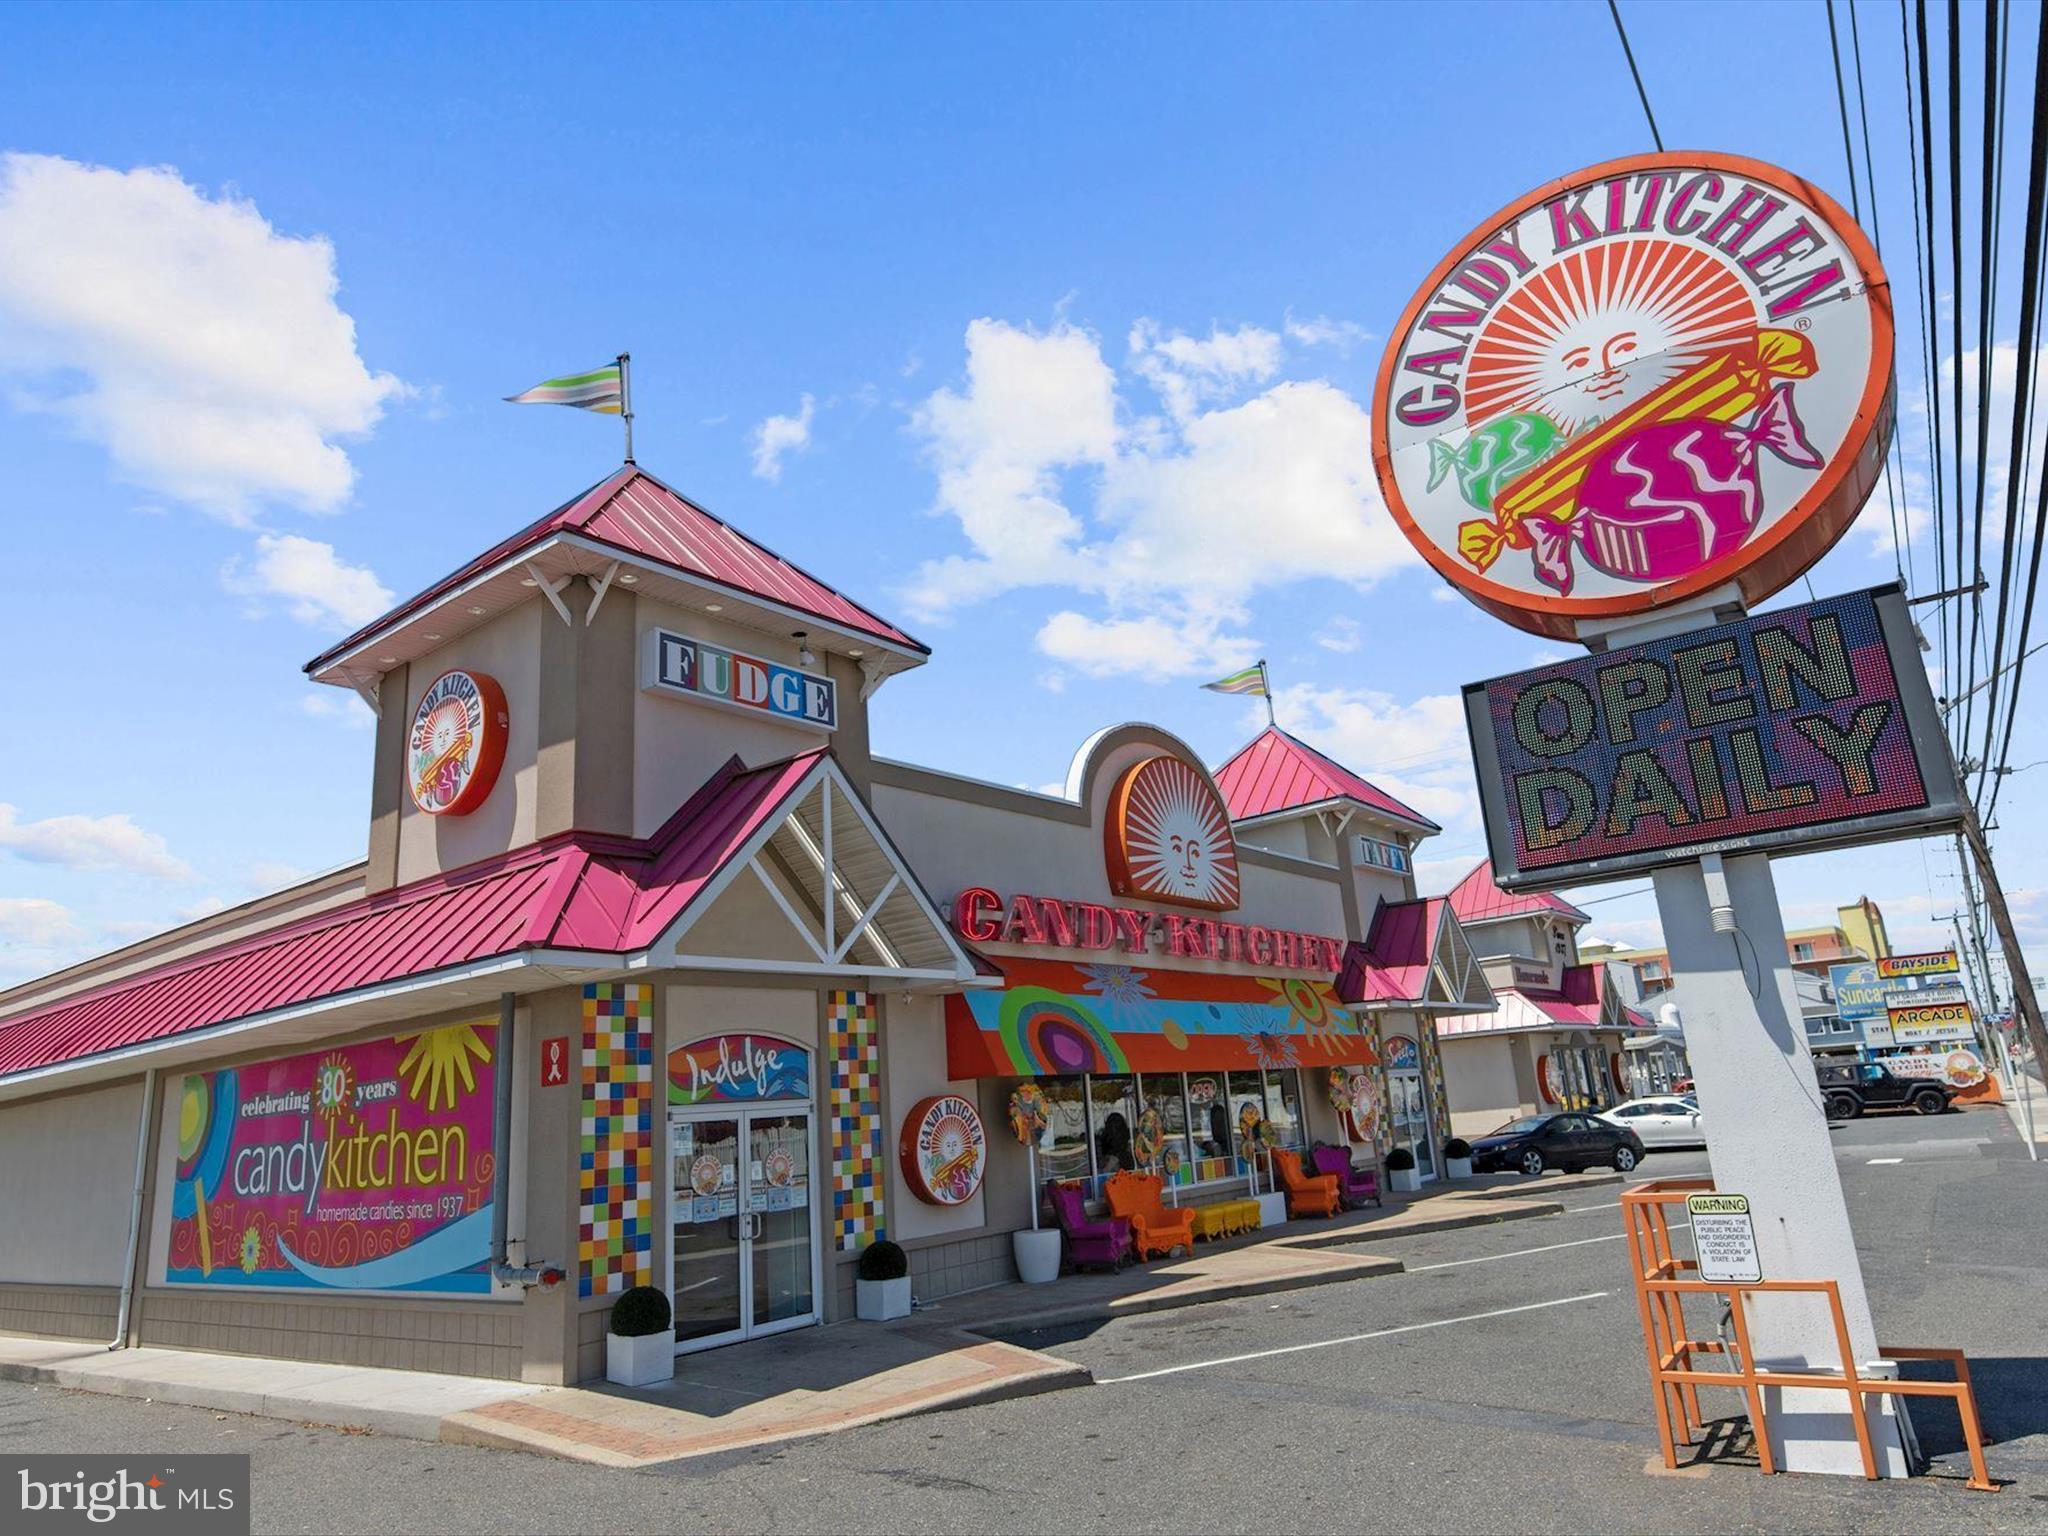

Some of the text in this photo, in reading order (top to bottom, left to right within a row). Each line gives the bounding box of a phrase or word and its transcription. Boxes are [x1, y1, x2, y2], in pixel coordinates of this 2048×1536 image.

[1395, 221, 1538, 428] CANDY
[1543, 171, 1852, 323] KITCHEN
[664, 638, 833, 723] FUDGE
[1514, 611, 1859, 758] OPEN
[412, 673, 481, 750] CANDY KITCHEN
[1515, 703, 1889, 852] DAILY
[955, 887, 1344, 973] CANDY KITCHEN
[1891, 955, 1949, 970] BAYSIDE
[1871, 1026, 1889, 1034] STAY
[1896, 1008, 1965, 1025] ARCADE
[241, 1069, 399, 1118] celebrating 80 years
[686, 1036, 784, 1101] Indulge
[920, 1099, 983, 1151] CANDY KITCHEN
[317, 1196, 464, 1222] homemade candies since 1937
[1691, 1199, 1746, 1211] WARNING
